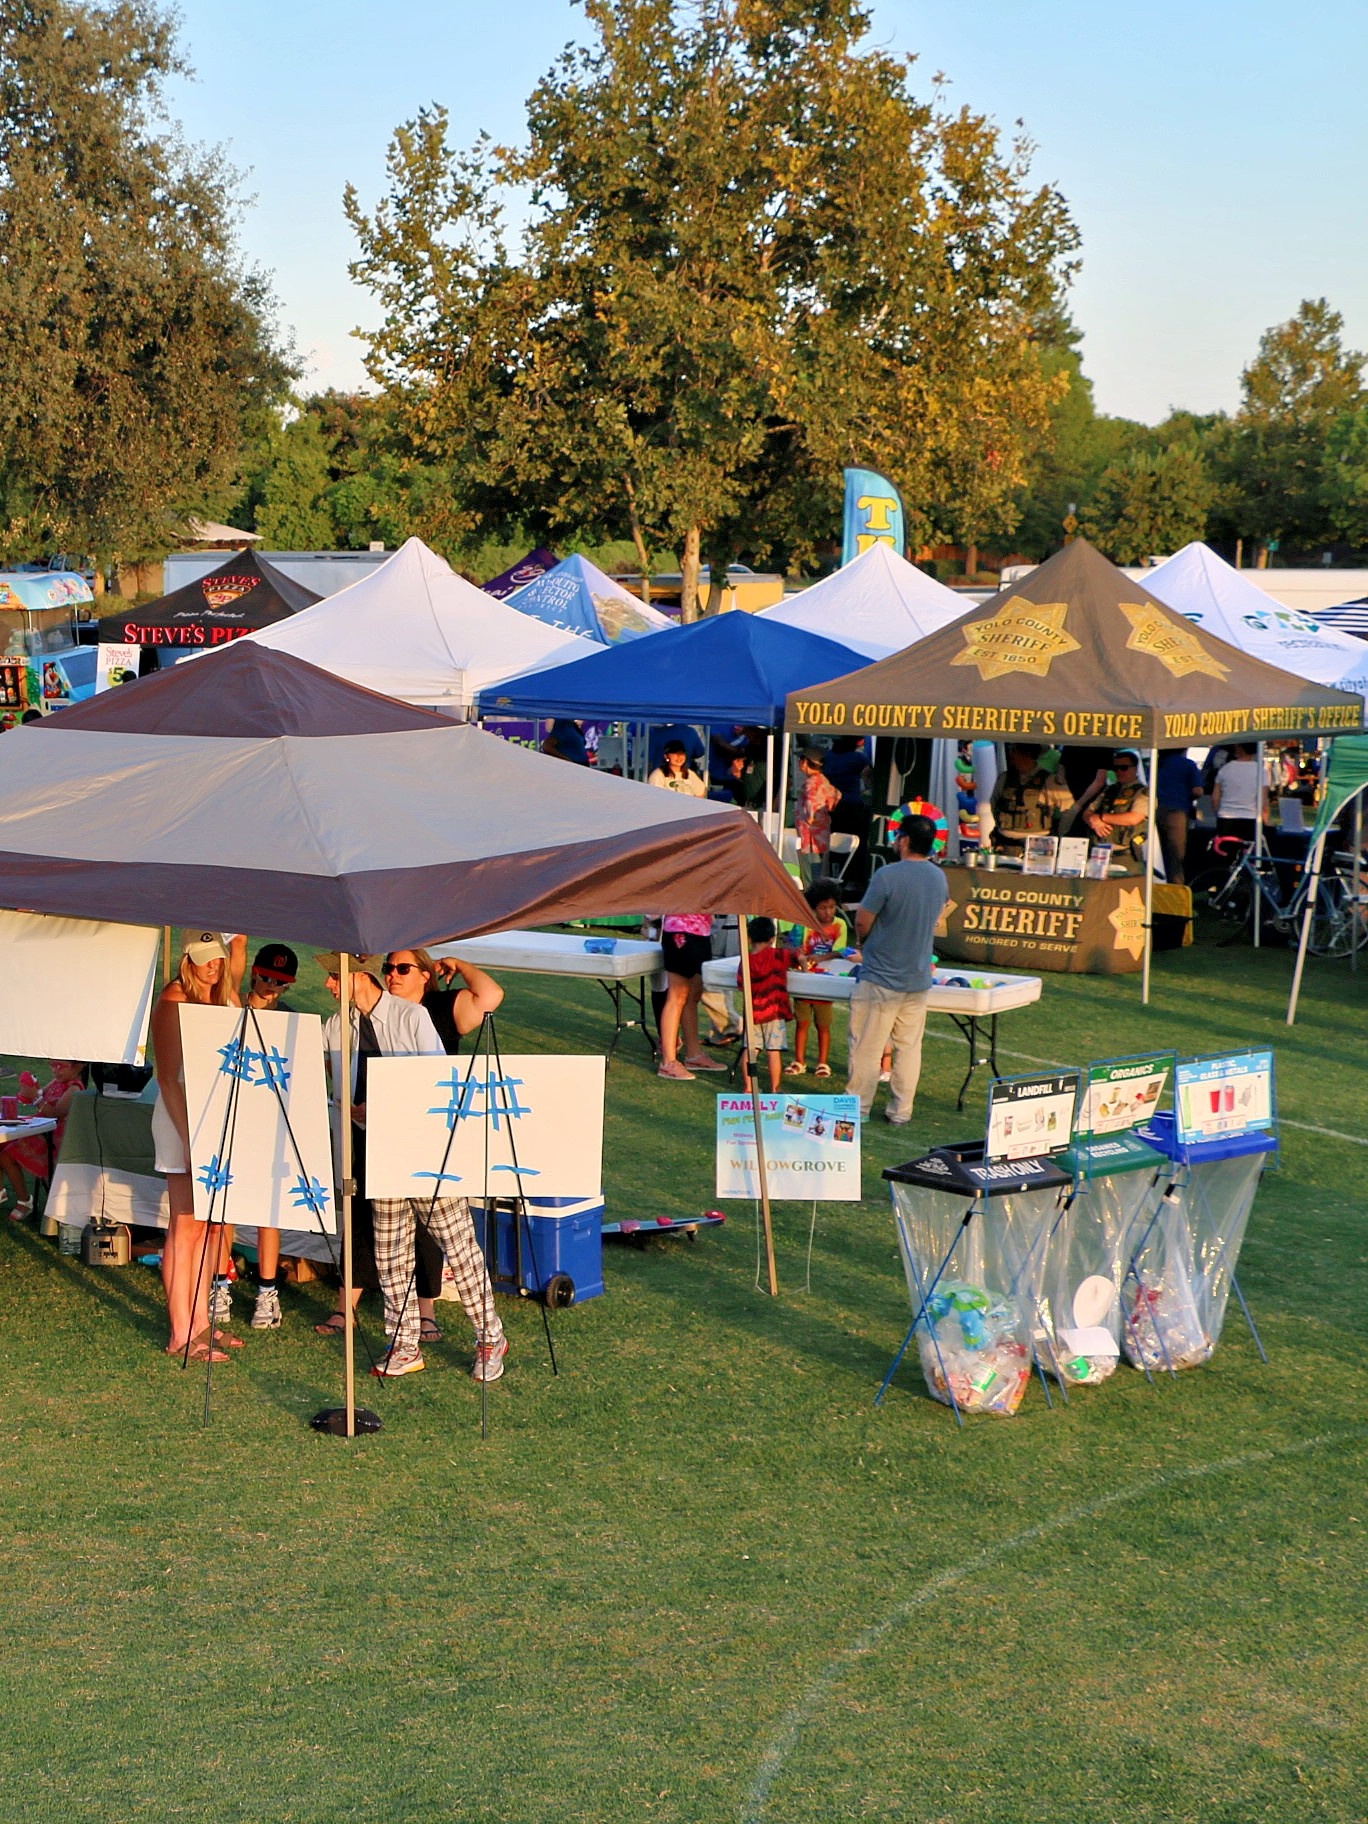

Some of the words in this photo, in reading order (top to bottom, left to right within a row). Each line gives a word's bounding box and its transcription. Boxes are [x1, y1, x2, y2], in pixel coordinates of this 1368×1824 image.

[124, 623, 206, 645] STEVE'S
[210, 627, 258, 645] PIZ
[975, 618, 1012, 633] YOLO
[1015, 617, 1068, 645] COUNTY
[979, 632, 1051, 652] SHERIFF
[1002, 653, 1037, 664] 1850
[796, 701, 846, 726] YOLO
[852, 704, 937, 729] COUNTY
[942, 706, 1056, 735] SHERIFF'S
[1063, 711, 1144, 739] OFFICE
[1164, 713, 1197, 738] YOLO
[1199, 708, 1251, 736] COUNTY
[1252, 706, 1316, 731] SHERIFF'S
[1317, 704, 1361, 729] OFFICE
[970, 887, 1011, 902] YOLO
[1015, 891, 1084, 907] COUNTY
[963, 903, 1083, 939] SHERIFF
[965, 935, 1019, 948] HONORED
[1022, 940, 1037, 949] TO
[1039, 943, 1079, 954] SERVE
[1109, 1063, 1155, 1080] ORGANICS
[1017, 1083, 1053, 1098] LANDFILL
[720, 1100, 779, 1111] FAMLY
[730, 1159, 847, 1173] WILOWGROVE
[969, 1165, 1014, 1181] TRASH
[1012, 1159, 1046, 1177] ONLY
